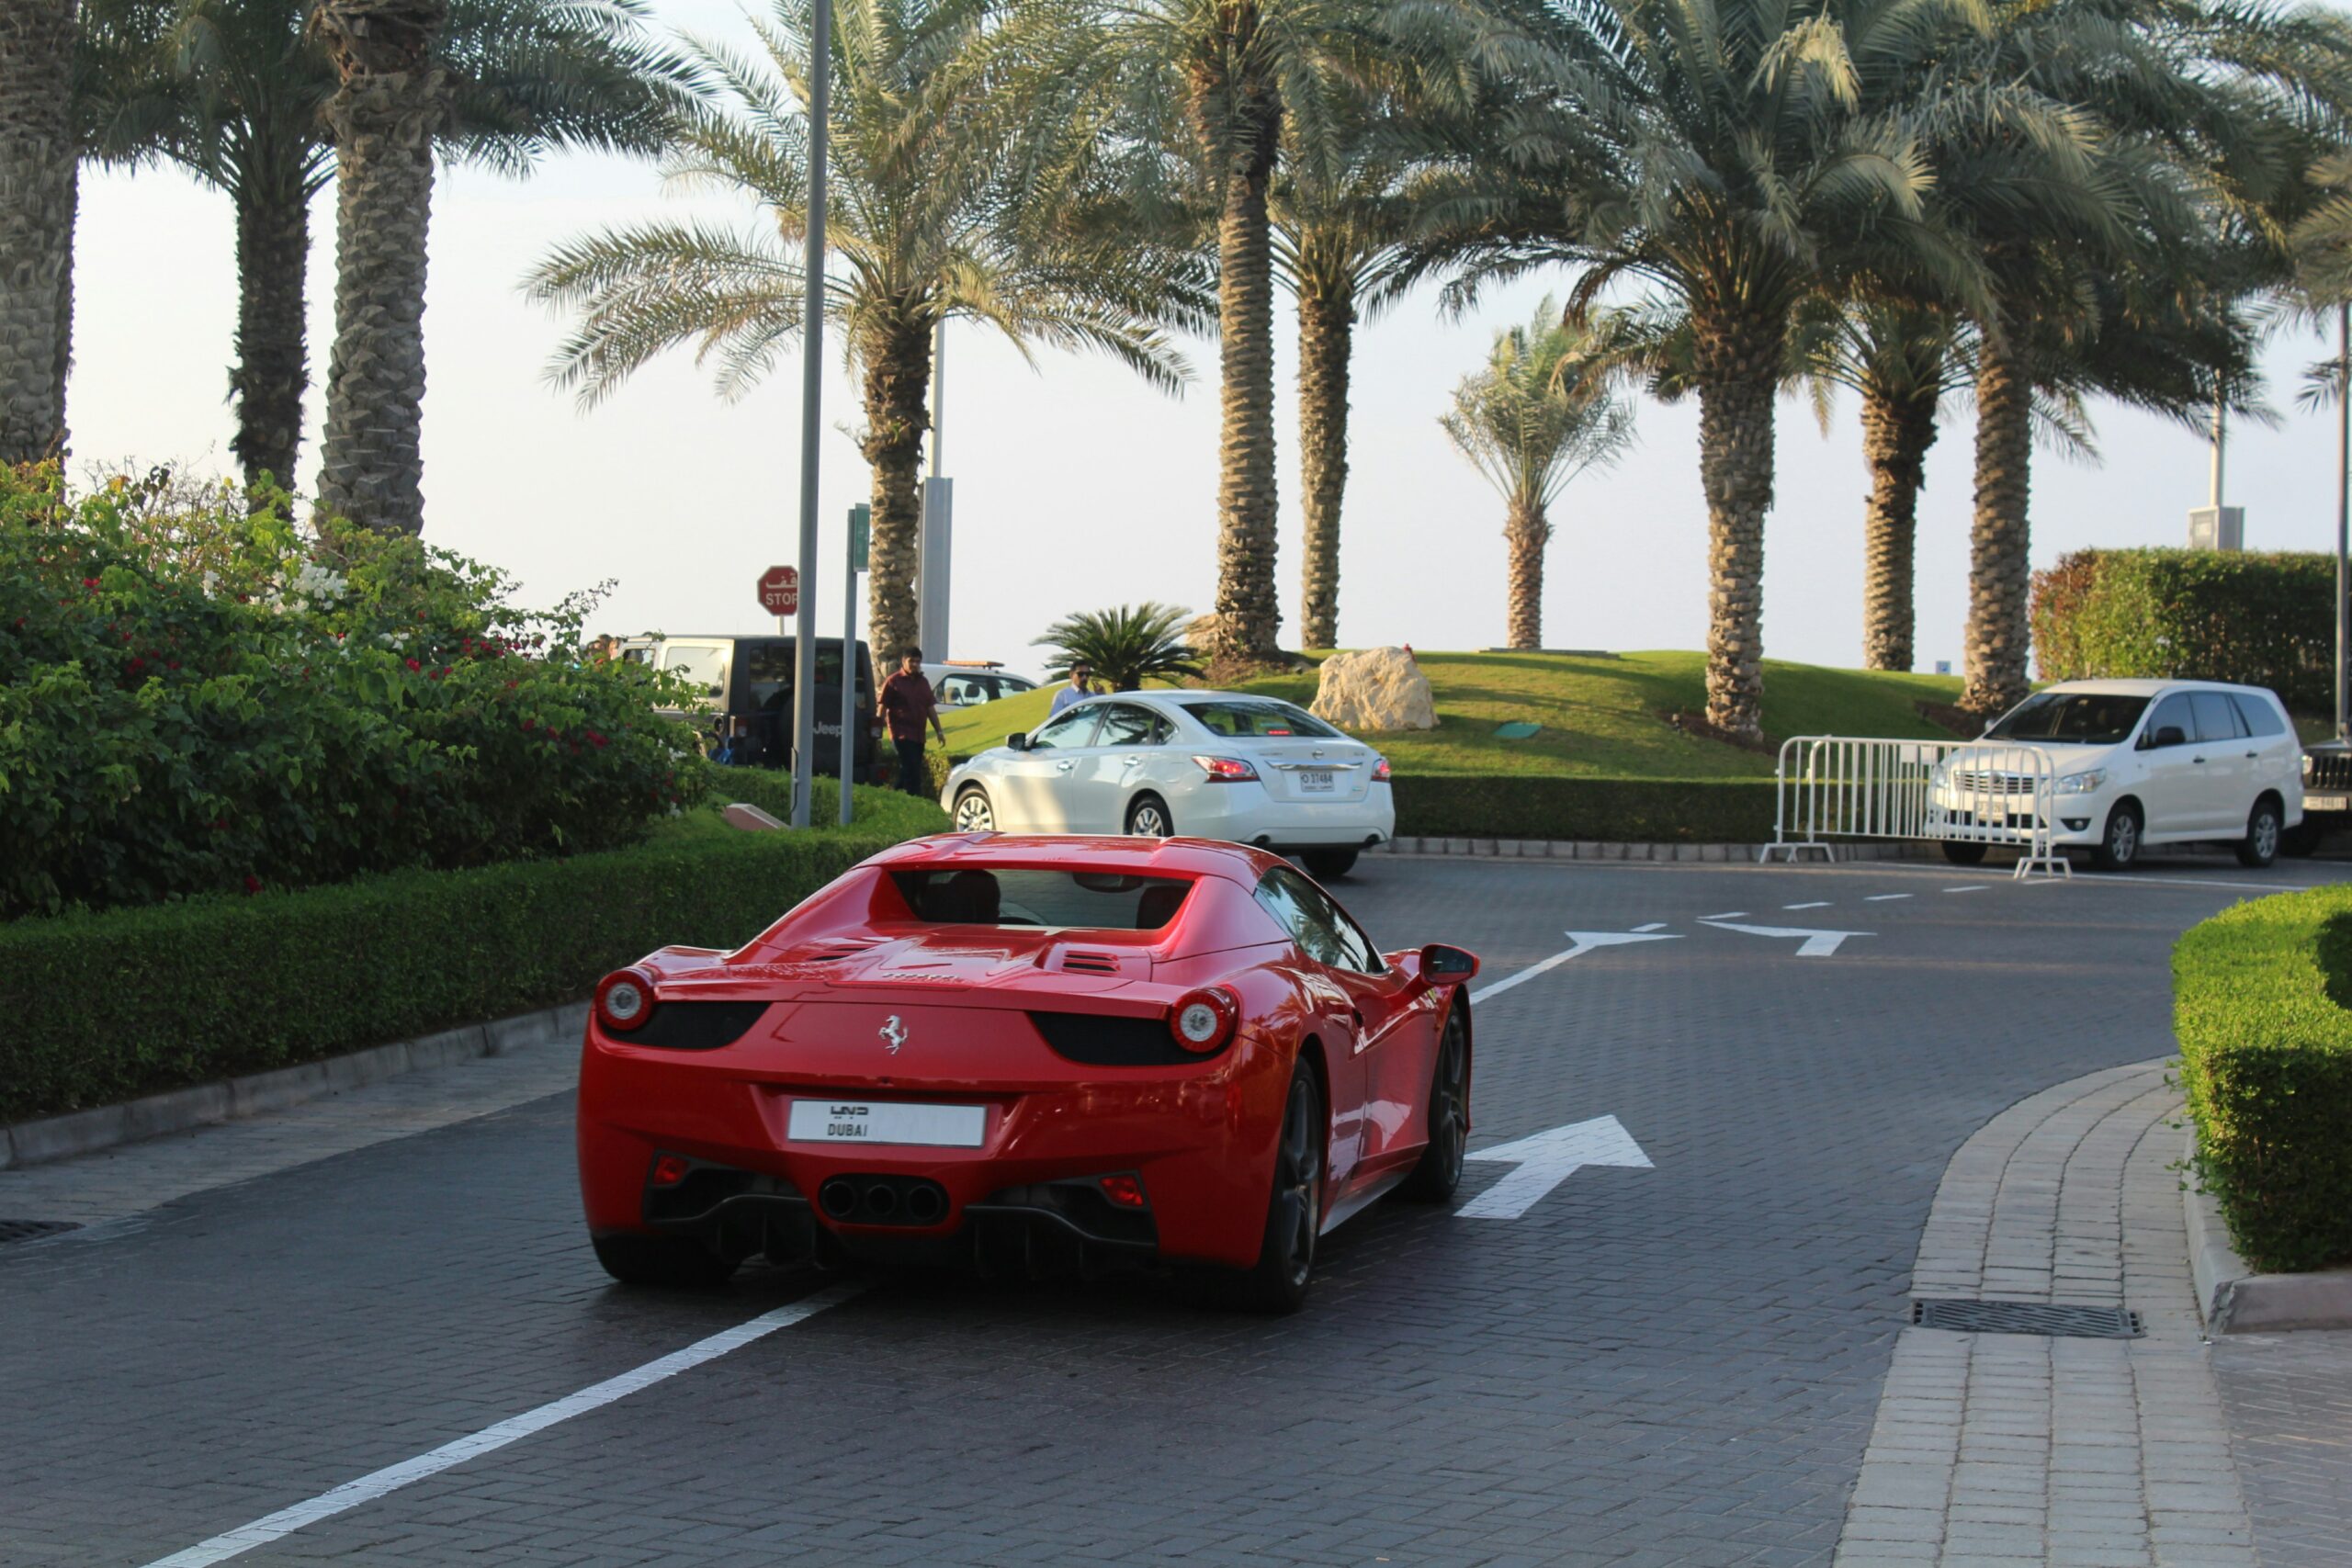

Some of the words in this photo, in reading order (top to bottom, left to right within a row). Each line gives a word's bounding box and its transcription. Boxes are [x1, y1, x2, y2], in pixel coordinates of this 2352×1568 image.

[765, 592, 797, 605] STOP
[812, 721, 842, 738] Jeep
[828, 1123, 868, 1137] DUBAI
